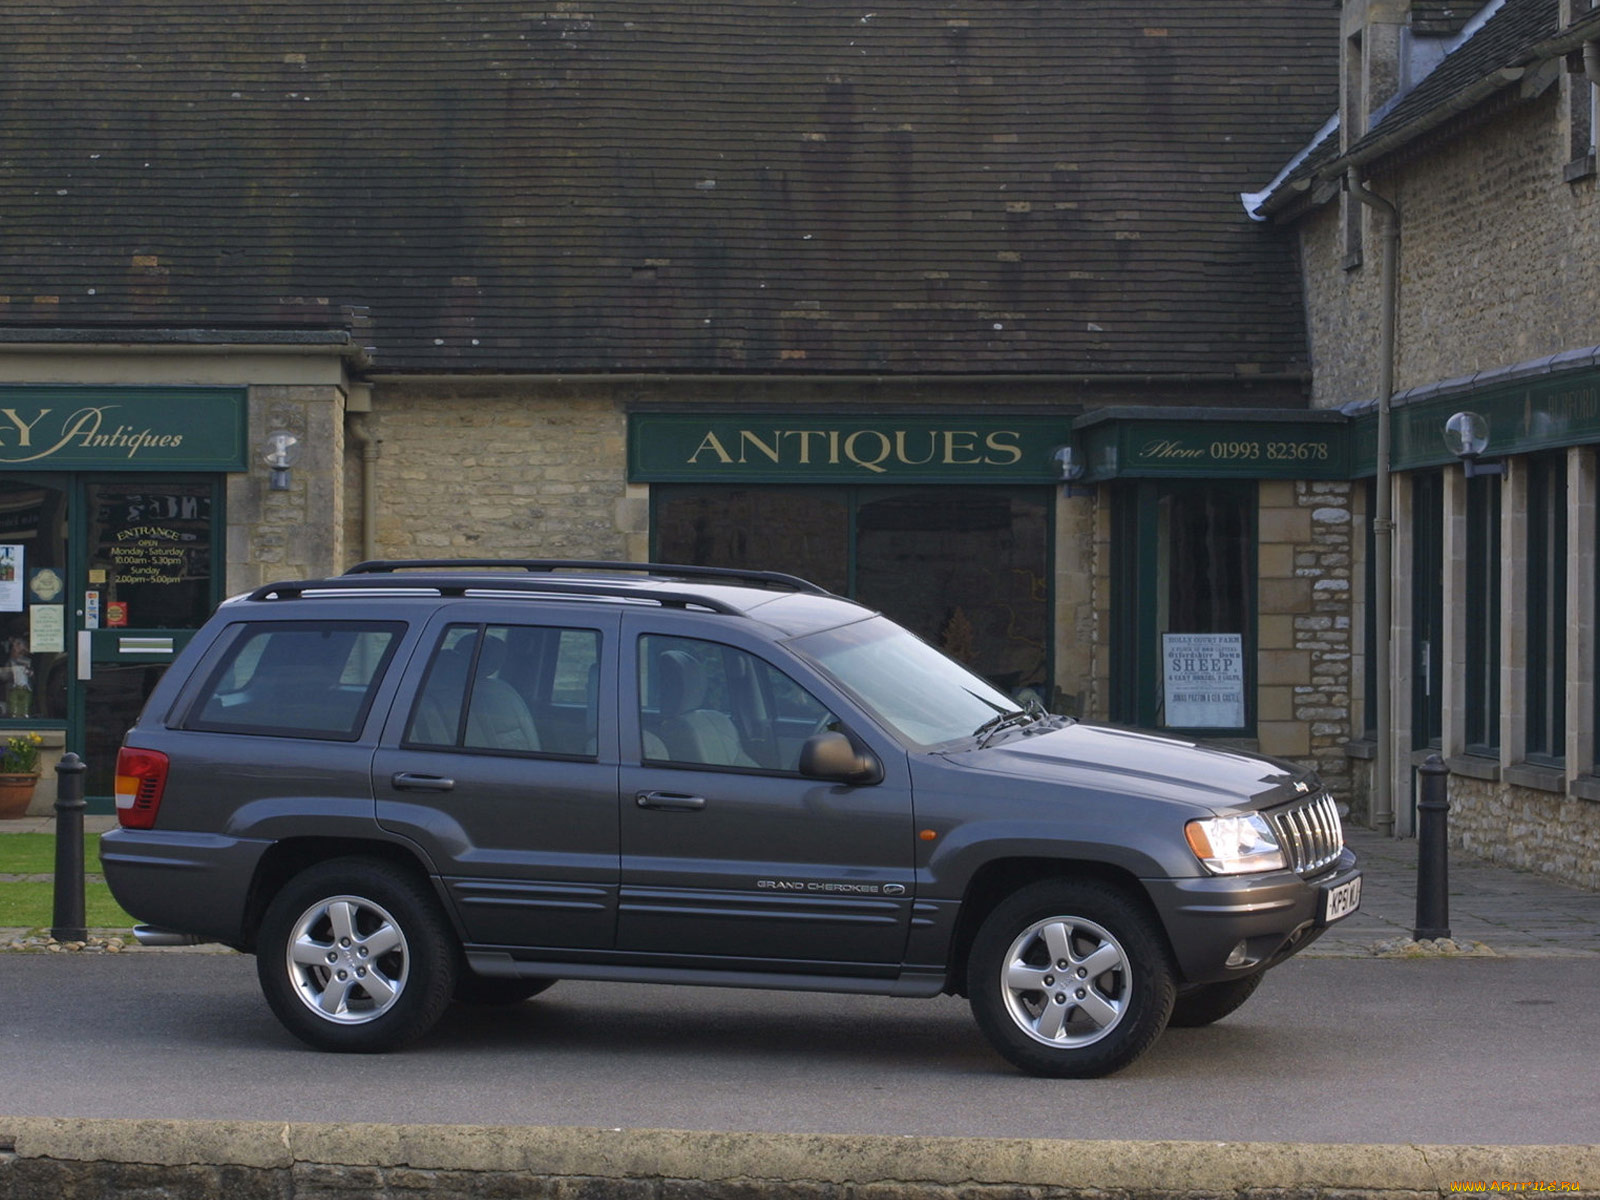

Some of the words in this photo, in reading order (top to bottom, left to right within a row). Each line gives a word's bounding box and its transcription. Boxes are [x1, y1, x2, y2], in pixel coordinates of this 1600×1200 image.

[58, 405, 183, 459] Antiques
[687, 430, 1022, 473] ANTIQUES
[1138, 440, 1205, 458] Phone
[1210, 442, 1259, 459] 01993
[1266, 442, 1328, 459] 823678
[116, 526, 180, 541] ENTRANCE
[111, 547, 144, 557] Monday
[149, 547, 185, 557] Saturday
[131, 566, 160, 575] Sunday
[1172, 659, 1238, 672] SHEEP.
[757, 880, 803, 890] GRAND
[807, 882, 879, 893] CHEROKEE
